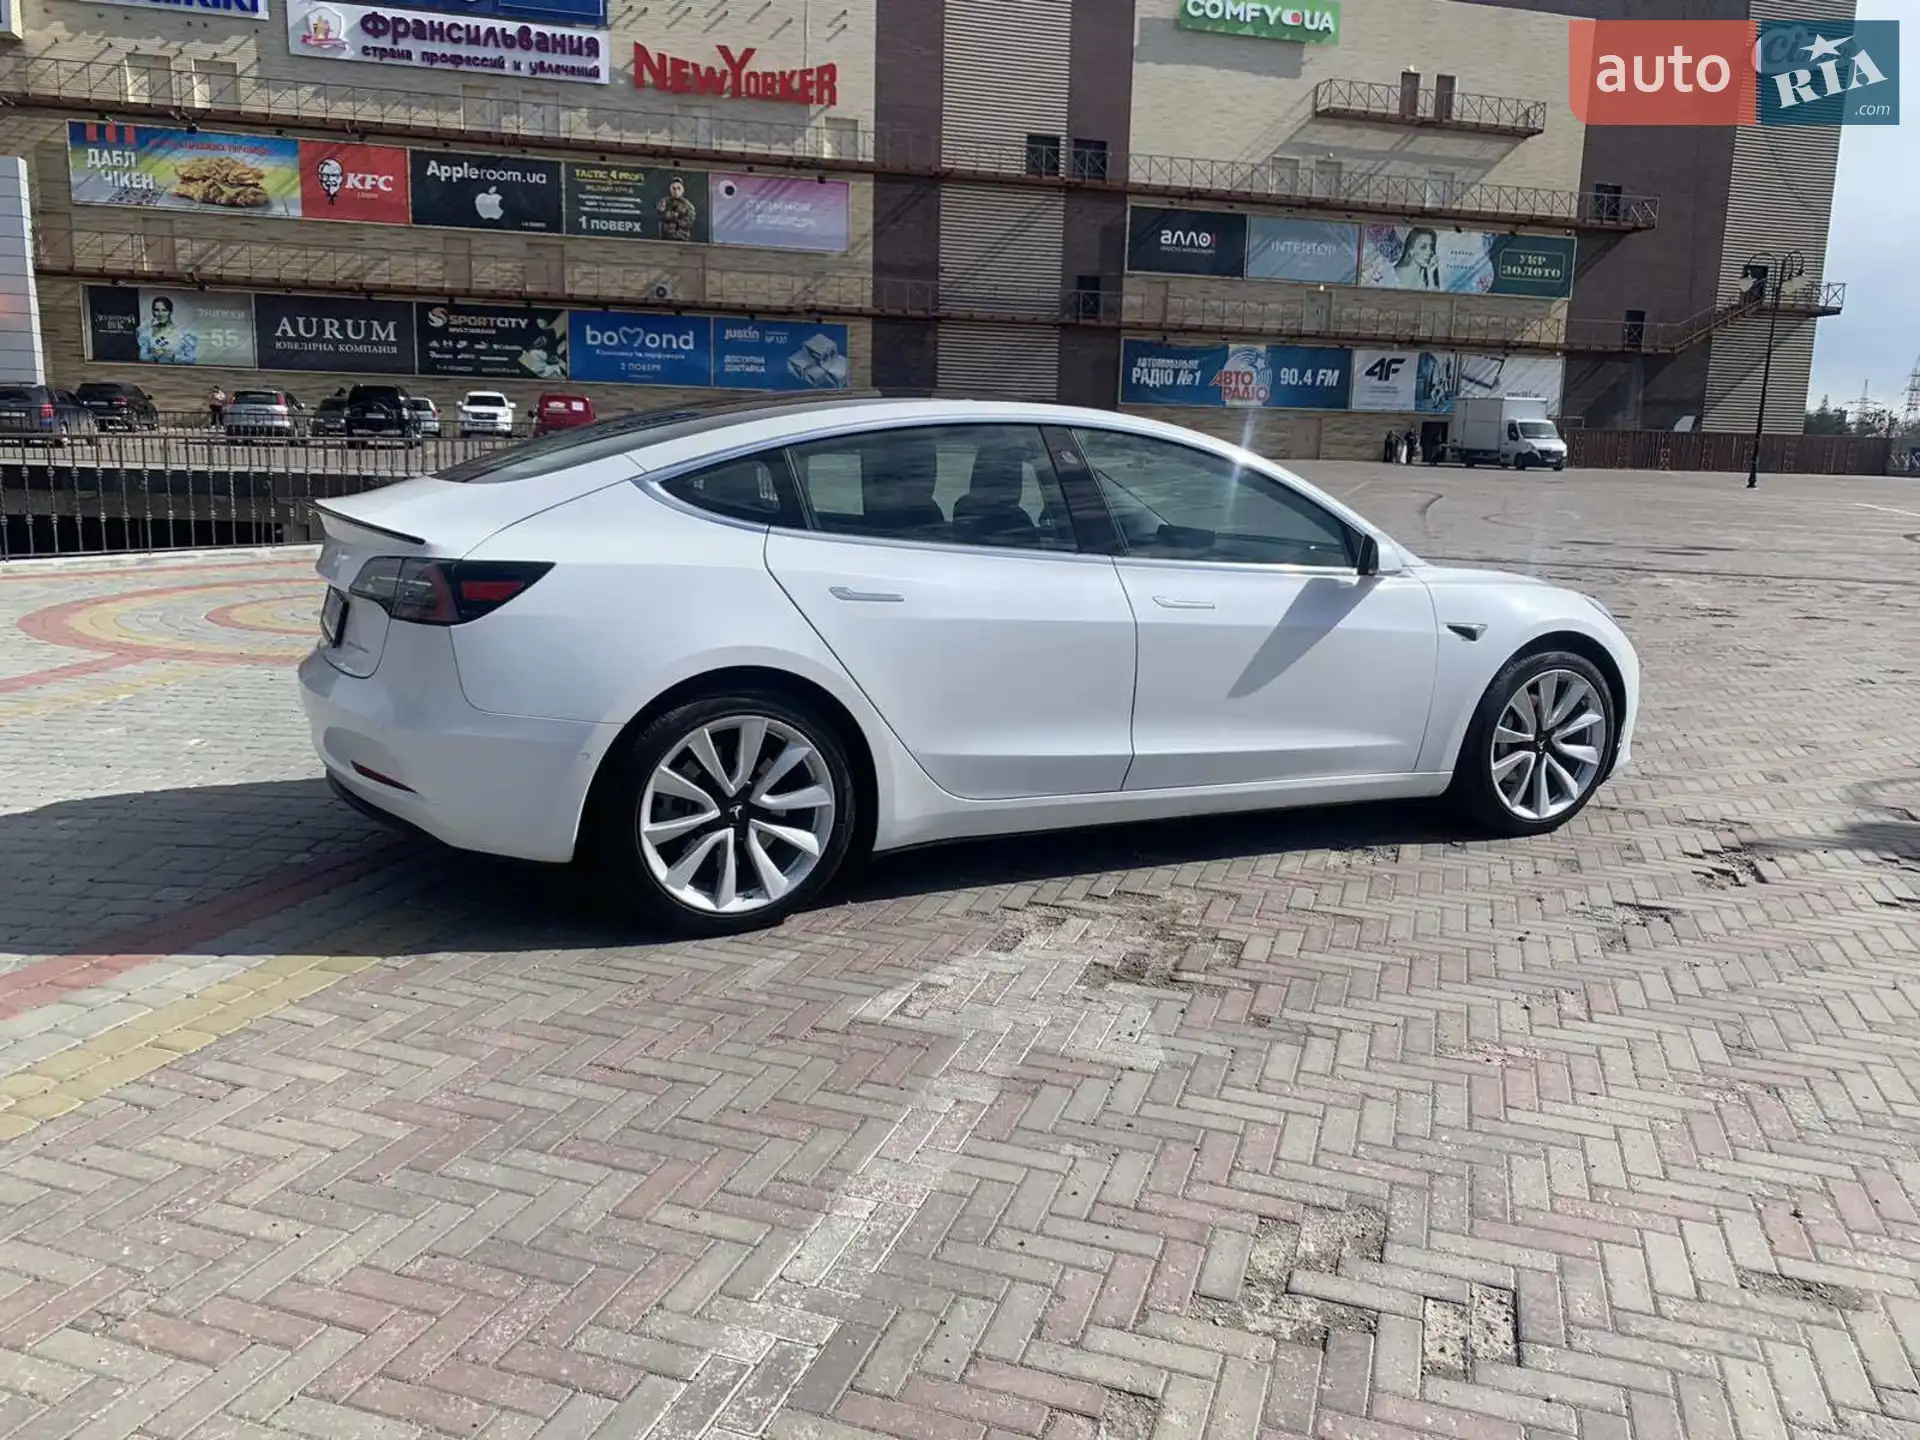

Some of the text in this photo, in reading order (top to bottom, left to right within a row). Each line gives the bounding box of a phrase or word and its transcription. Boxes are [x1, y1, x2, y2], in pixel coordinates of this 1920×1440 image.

[360, 11, 601, 58] Франсильвания
[361, 44, 601, 79] страна профессий и увлечений
[87, 148, 138, 169] ДАБЛ
[346, 172, 394, 192] KFC
[426, 159, 547, 185] Appleroom.ua
[579, 215, 642, 233] 1 ПОВЕРХ
[1519, 254, 1547, 265] УКР
[1501, 264, 1563, 279] ЗОЛОТО
[275, 316, 398, 342] AURUM
[275, 341, 398, 354] ЮВЕЛІРНА КОМПАНІЯ
[1131, 367, 1174, 388] РАДІО
[1209, 370, 1254, 387] АВТО
[1280, 367, 1340, 387] 90.4 FM
[1365, 357, 1406, 381] 4F
